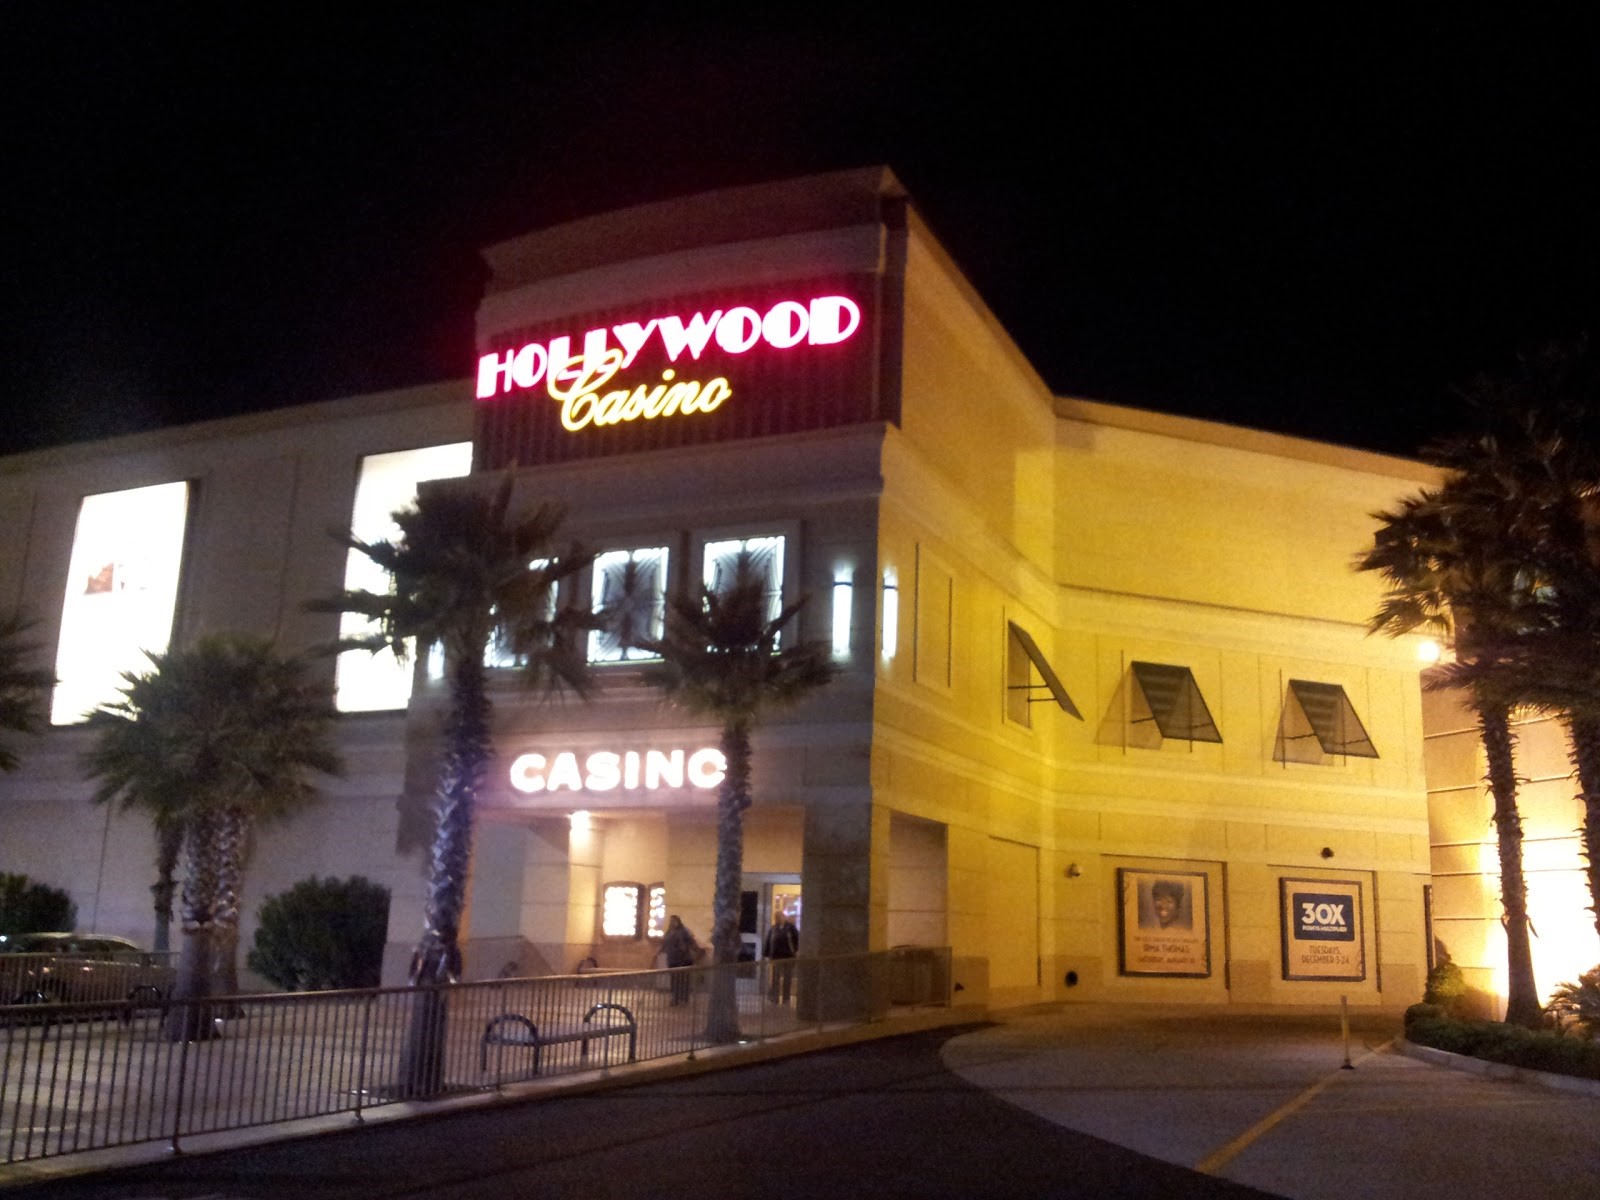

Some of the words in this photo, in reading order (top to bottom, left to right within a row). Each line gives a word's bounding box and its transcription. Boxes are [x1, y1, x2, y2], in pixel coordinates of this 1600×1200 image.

[477, 296, 861, 399] HOLLYWOOD
[547, 348, 732, 431] Casino
[510, 748, 727, 793] CASINO
[1302, 903, 1346, 925] 30X
[1302, 955, 1334, 964] DECEMBER
